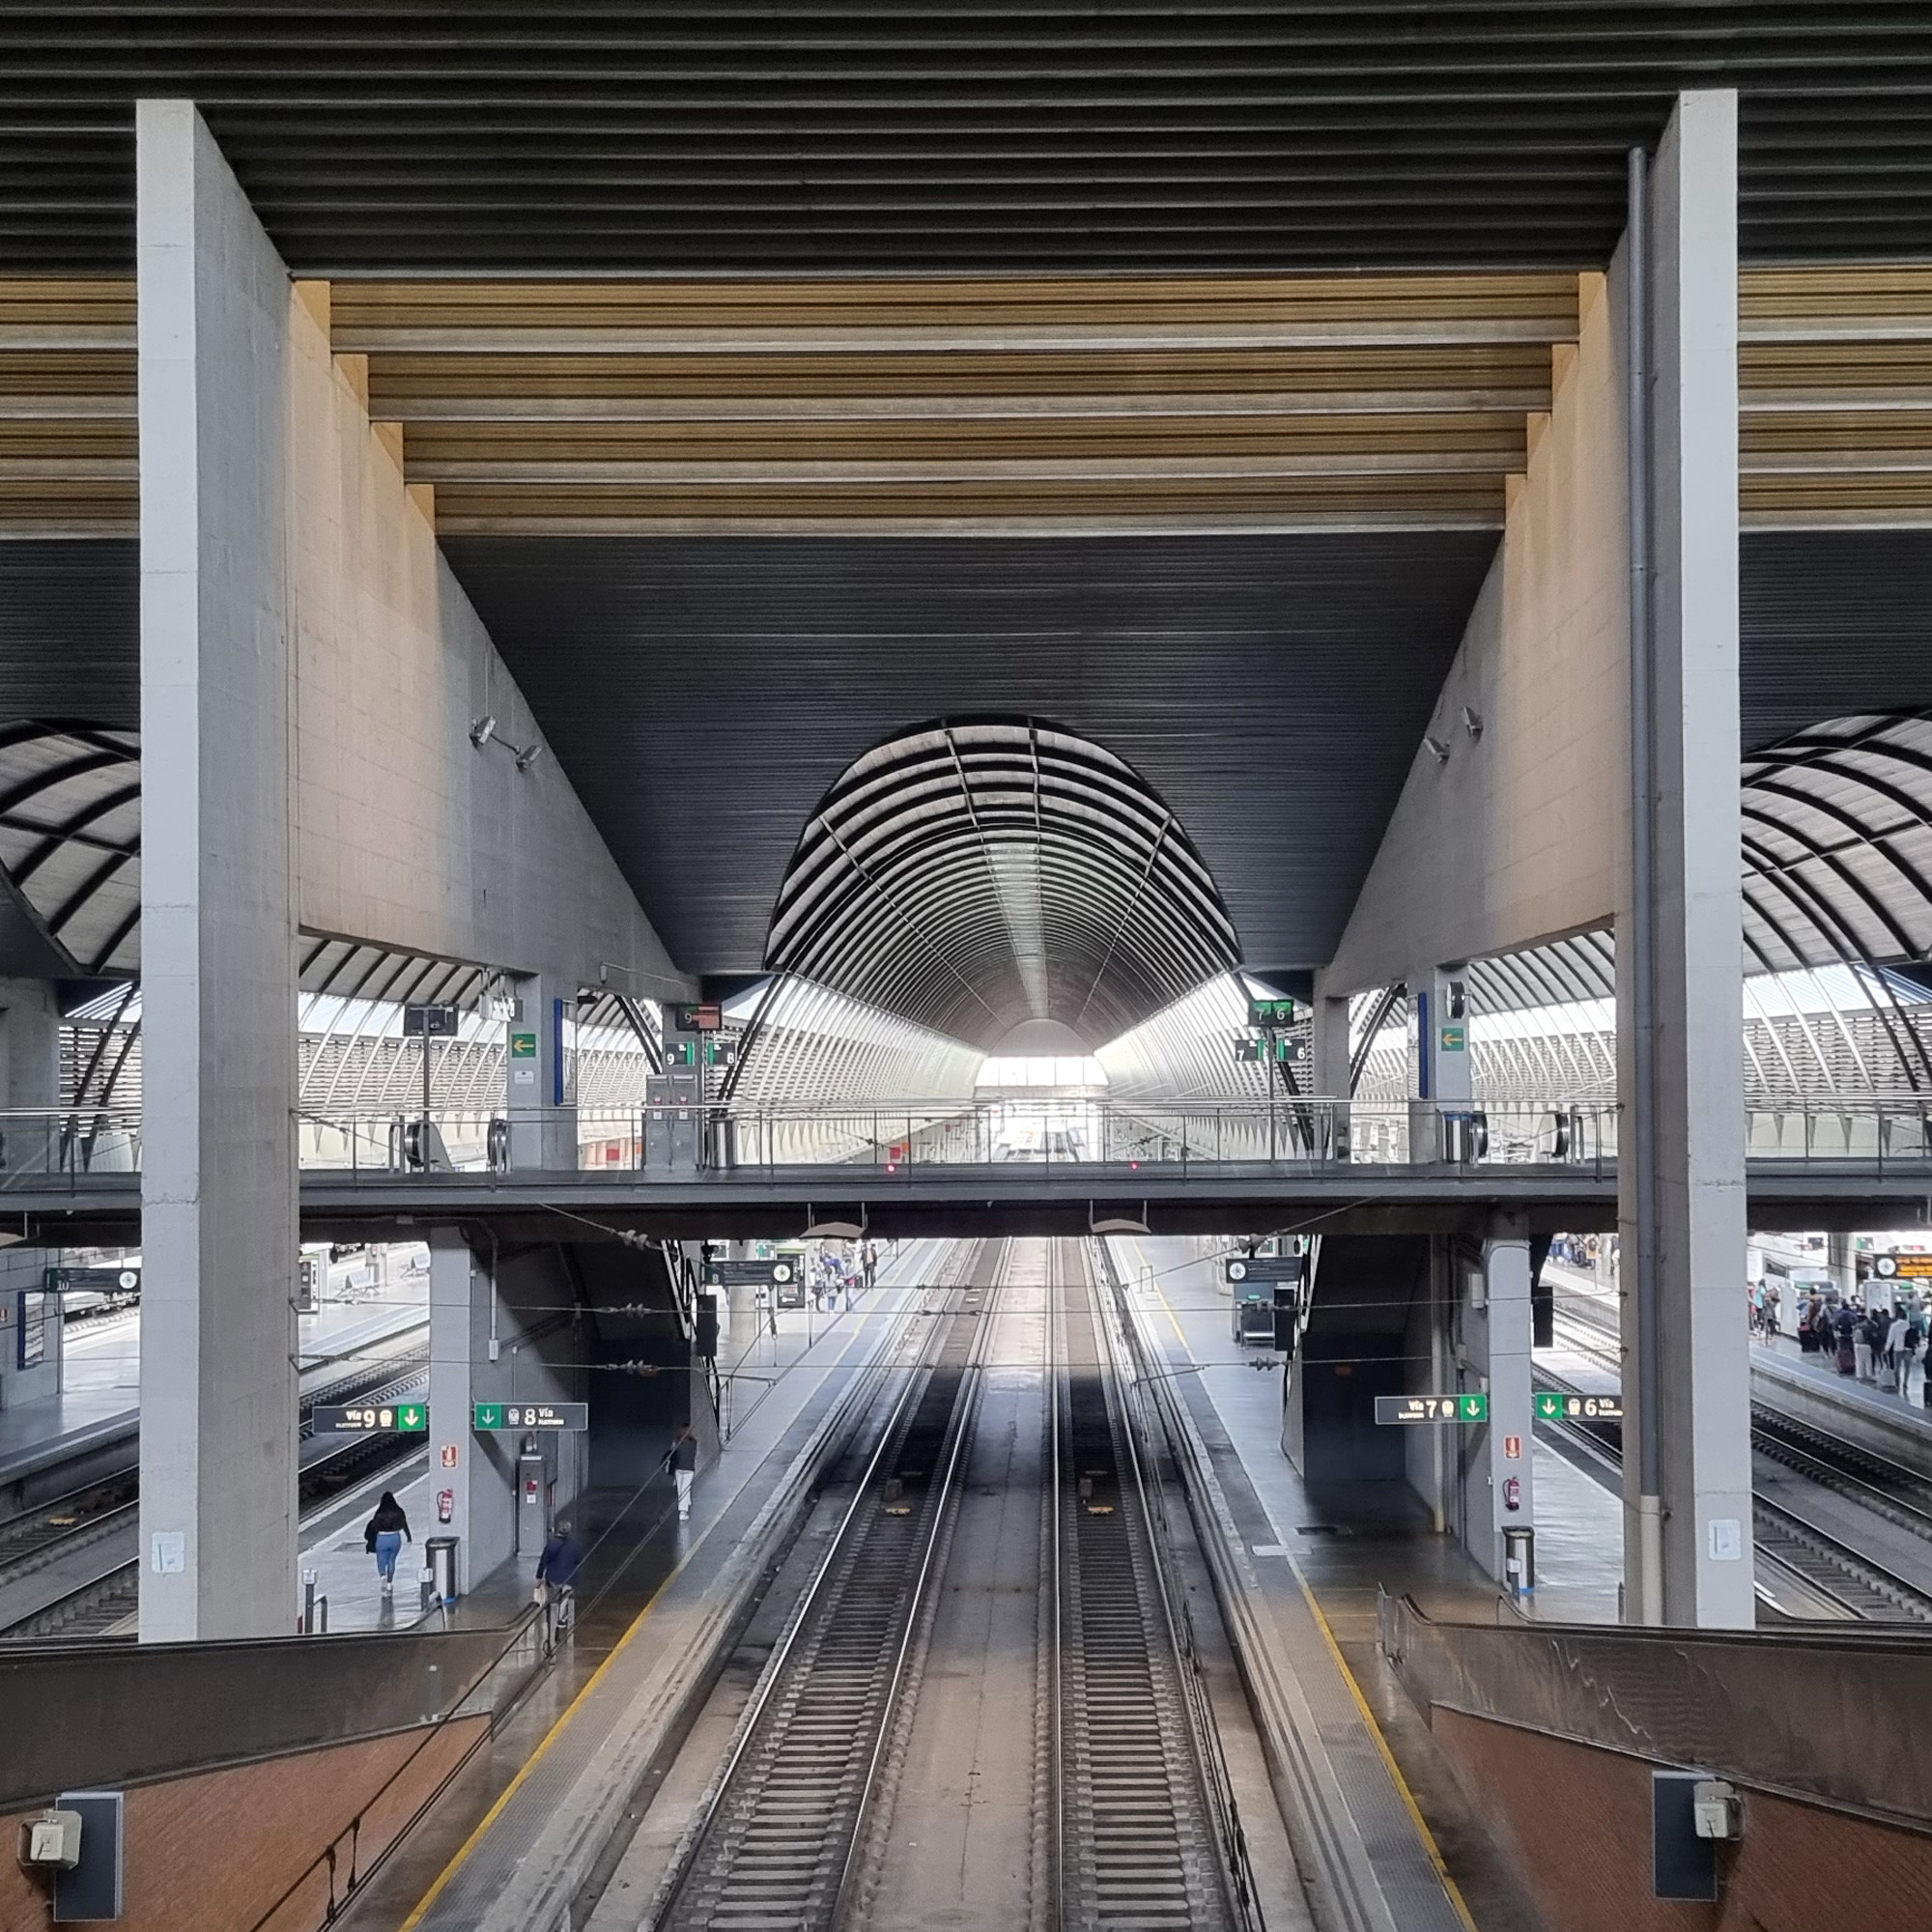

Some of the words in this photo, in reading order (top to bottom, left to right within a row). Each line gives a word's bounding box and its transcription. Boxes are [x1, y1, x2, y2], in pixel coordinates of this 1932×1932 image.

[684, 1012, 693, 1024] 9
[1256, 1009, 1264, 1020] 7
[1276, 1009, 1286, 1020] 6
[667, 1053, 674, 1065] 9
[1237, 1050, 1245, 1061] 7
[1296, 1047, 1305, 1060] 6
[1426, 1400, 1437, 1418] 7
[1585, 1398, 1597, 1416] 6
[363, 1409, 375, 1428] 9
[525, 1408, 536, 1425] 8
